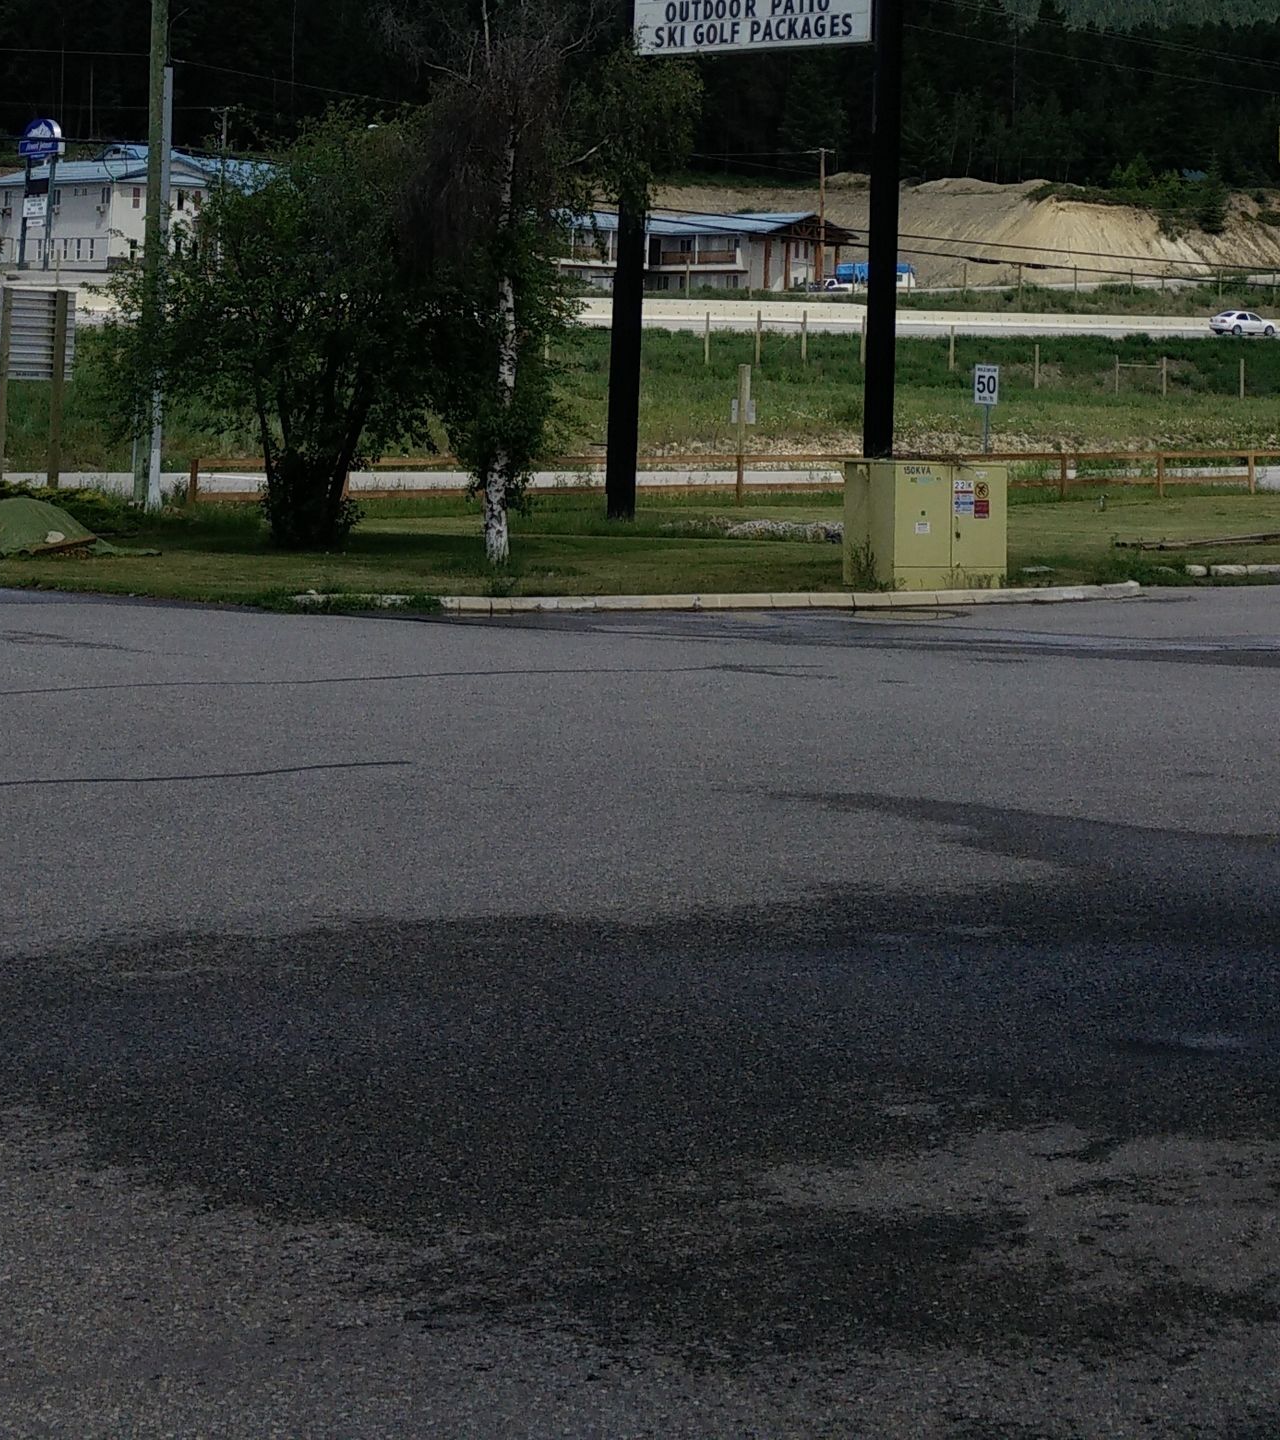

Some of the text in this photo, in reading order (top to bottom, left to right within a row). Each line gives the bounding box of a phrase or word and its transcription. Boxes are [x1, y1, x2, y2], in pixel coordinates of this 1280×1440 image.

[654, 13, 853, 48] SKI GOLF PACKAGES
[977, 375, 996, 394] 50
[904, 466, 931, 475] 150KVA
